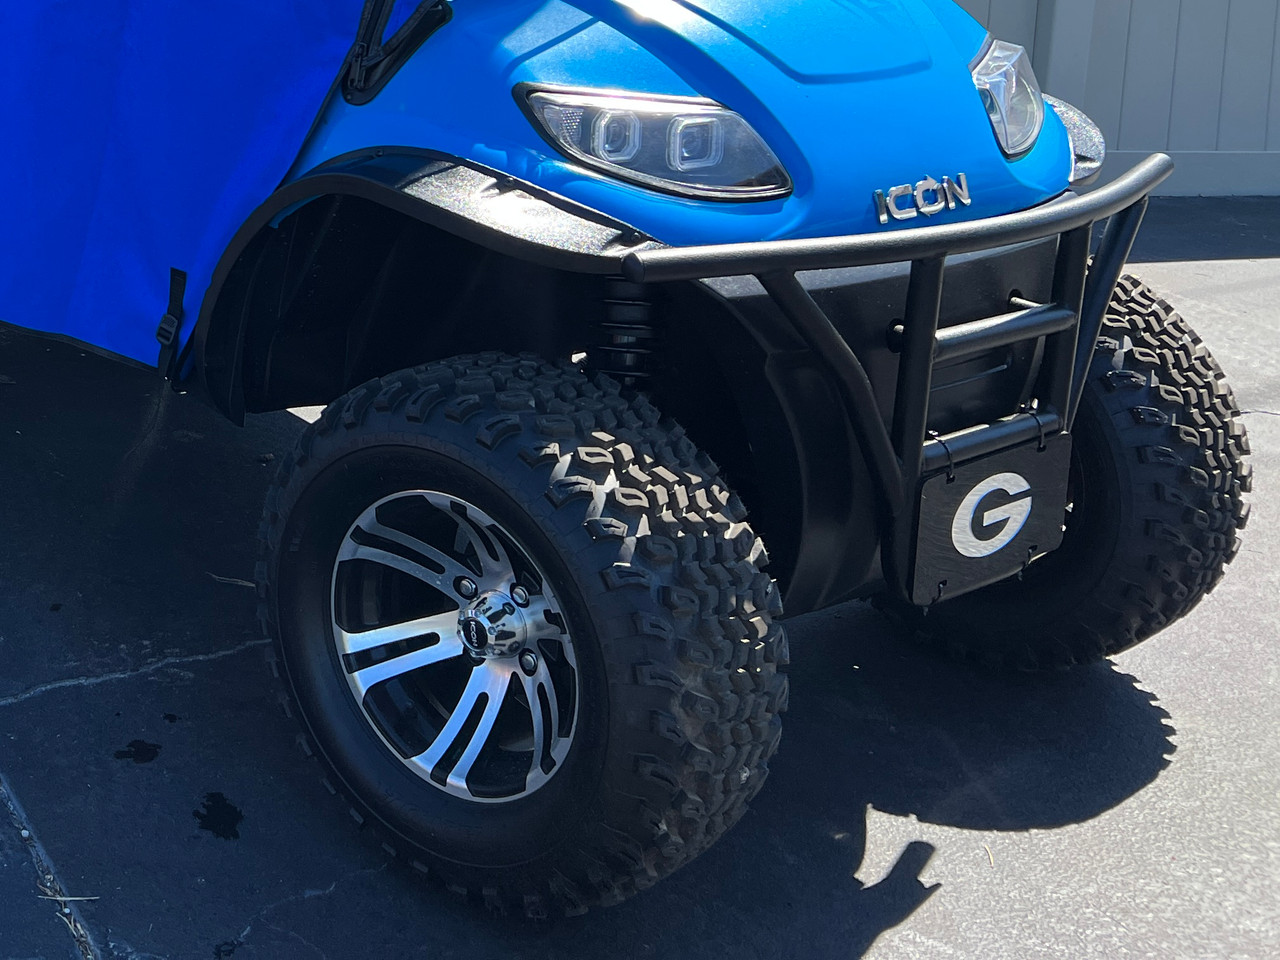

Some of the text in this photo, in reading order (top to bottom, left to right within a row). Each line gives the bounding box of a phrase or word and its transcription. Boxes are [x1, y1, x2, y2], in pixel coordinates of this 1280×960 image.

[874, 172, 972, 224] ICON
[951, 472, 1033, 558] G
[470, 621, 478, 647] ICON
